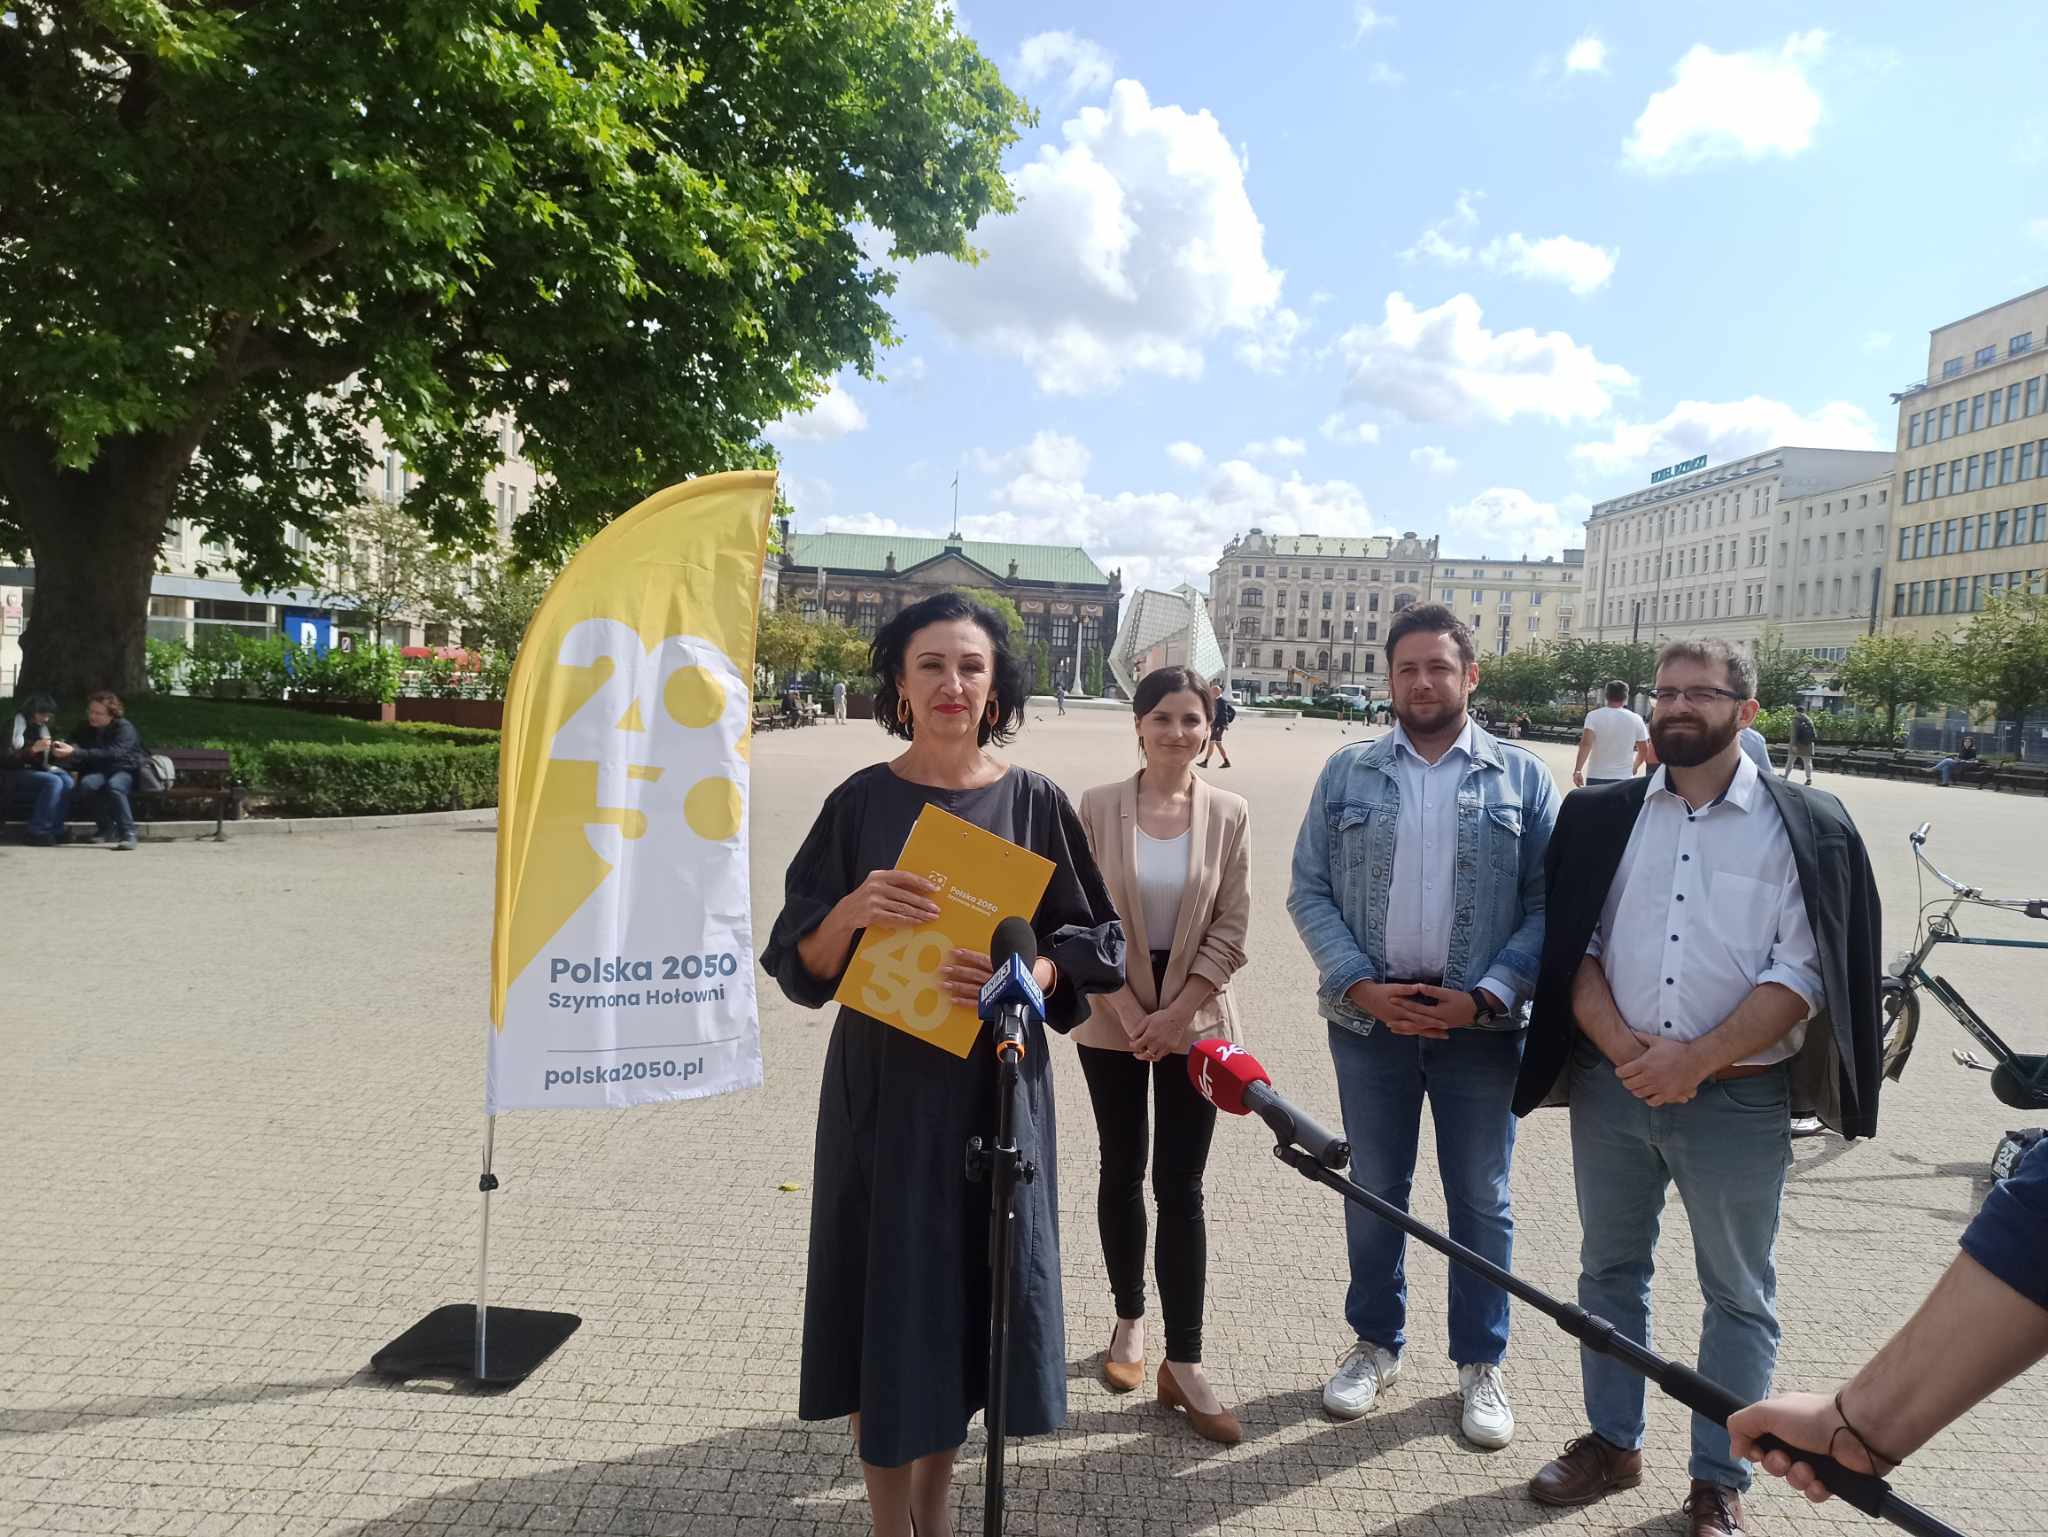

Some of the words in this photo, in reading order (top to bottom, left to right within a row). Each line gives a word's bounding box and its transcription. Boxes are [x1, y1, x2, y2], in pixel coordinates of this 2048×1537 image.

[550, 956, 653, 984] Polska
[662, 952, 738, 981] 2050
[548, 991, 641, 1014] Szymona
[646, 983, 725, 1006] Hołowni
[544, 1057, 704, 1090] polska2050.pl
